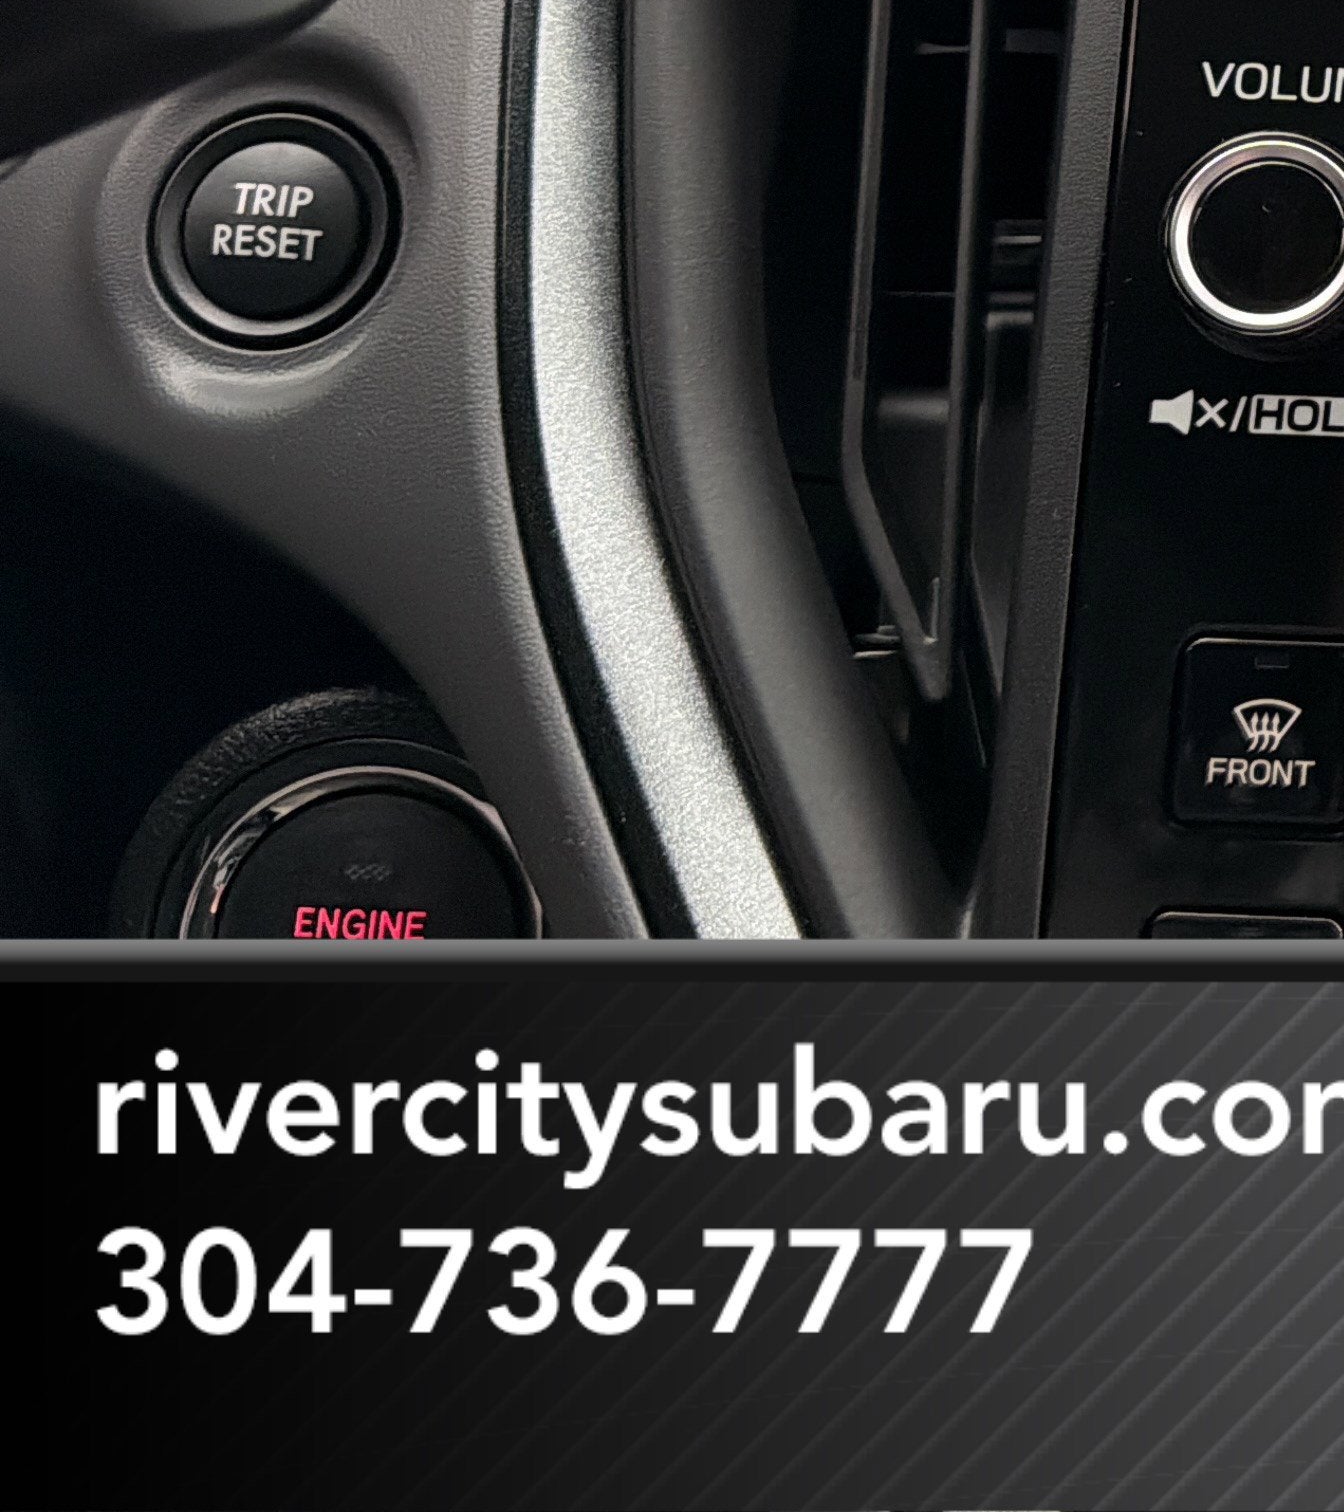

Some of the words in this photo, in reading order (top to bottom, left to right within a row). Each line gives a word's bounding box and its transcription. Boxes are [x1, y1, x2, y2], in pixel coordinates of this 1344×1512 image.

[233, 182, 315, 218] TRIP
[211, 223, 324, 261] RESET
[1205, 756, 1317, 789] FRONT
[293, 905, 428, 939] ENGINE
